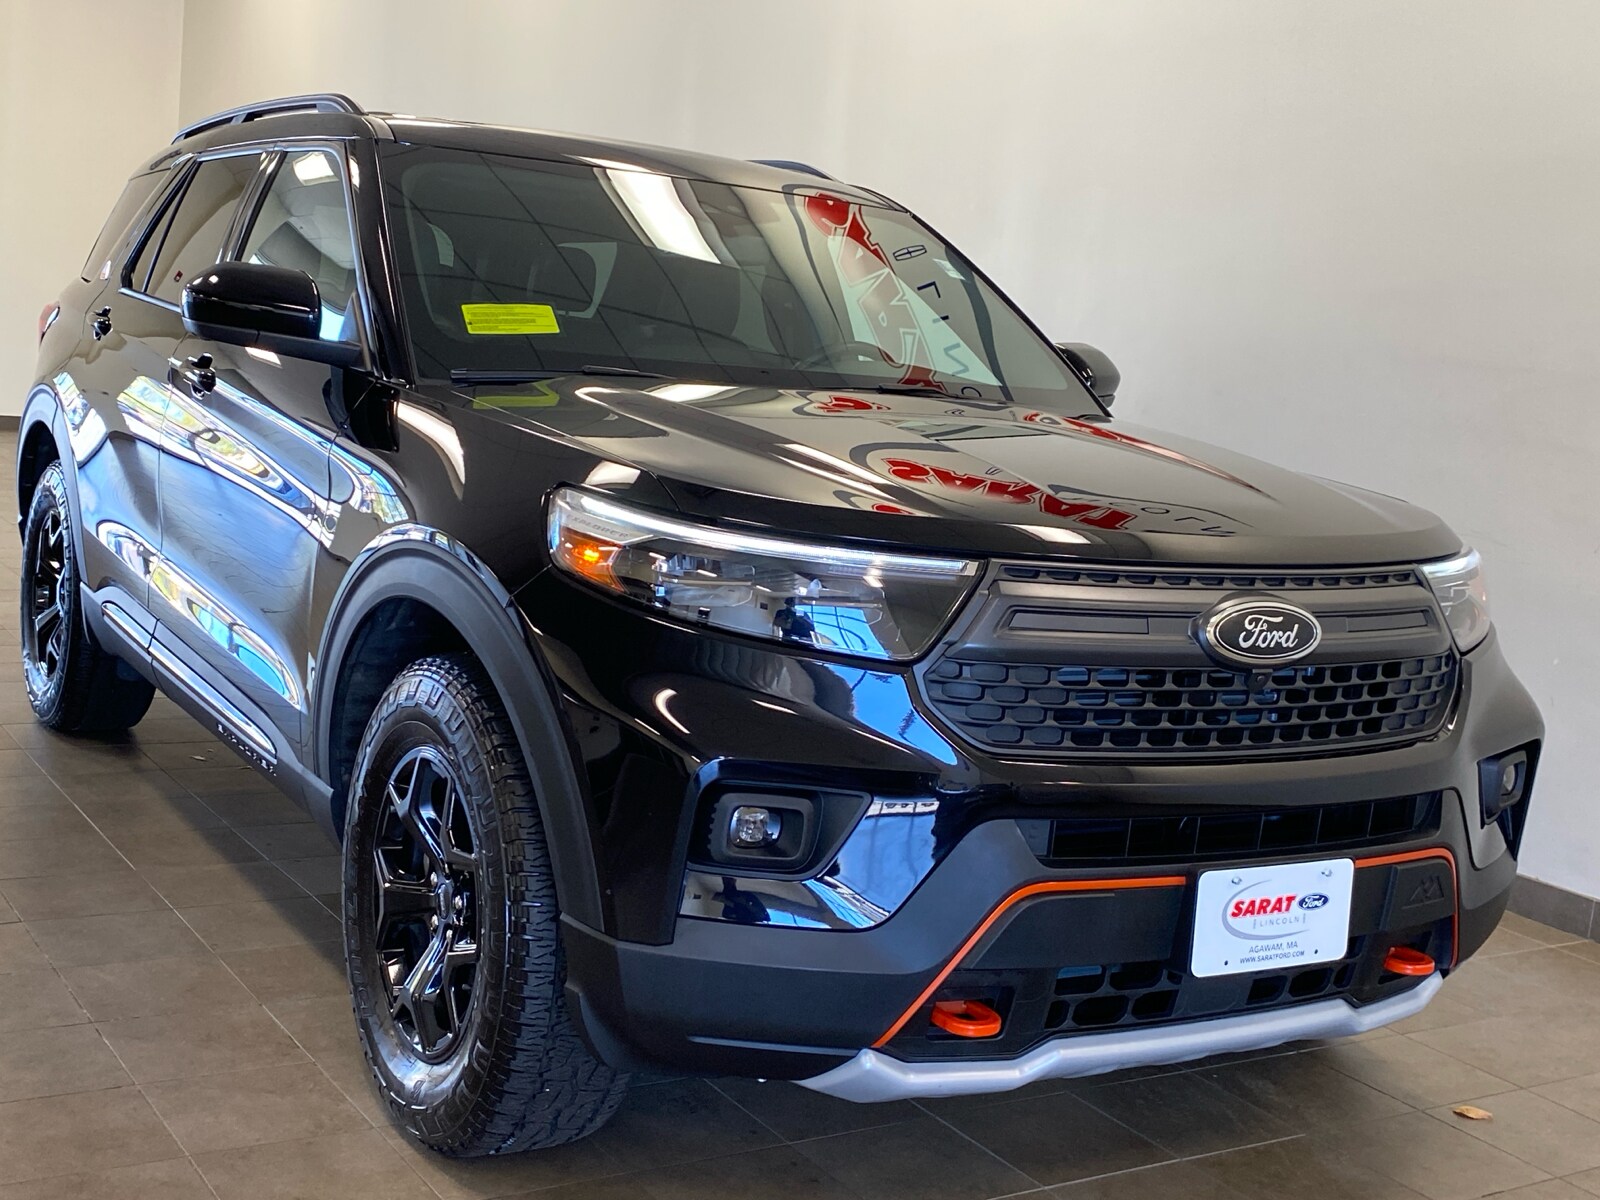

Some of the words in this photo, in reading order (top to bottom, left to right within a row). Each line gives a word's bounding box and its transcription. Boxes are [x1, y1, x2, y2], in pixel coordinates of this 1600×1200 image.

[1238, 614, 1299, 649] Ford
[1231, 894, 1297, 917] SARAT
[1259, 916, 1300, 928] LINCOLN
[1249, 943, 1285, 953] AGAWAM,
[1286, 941, 1298, 950] MA
